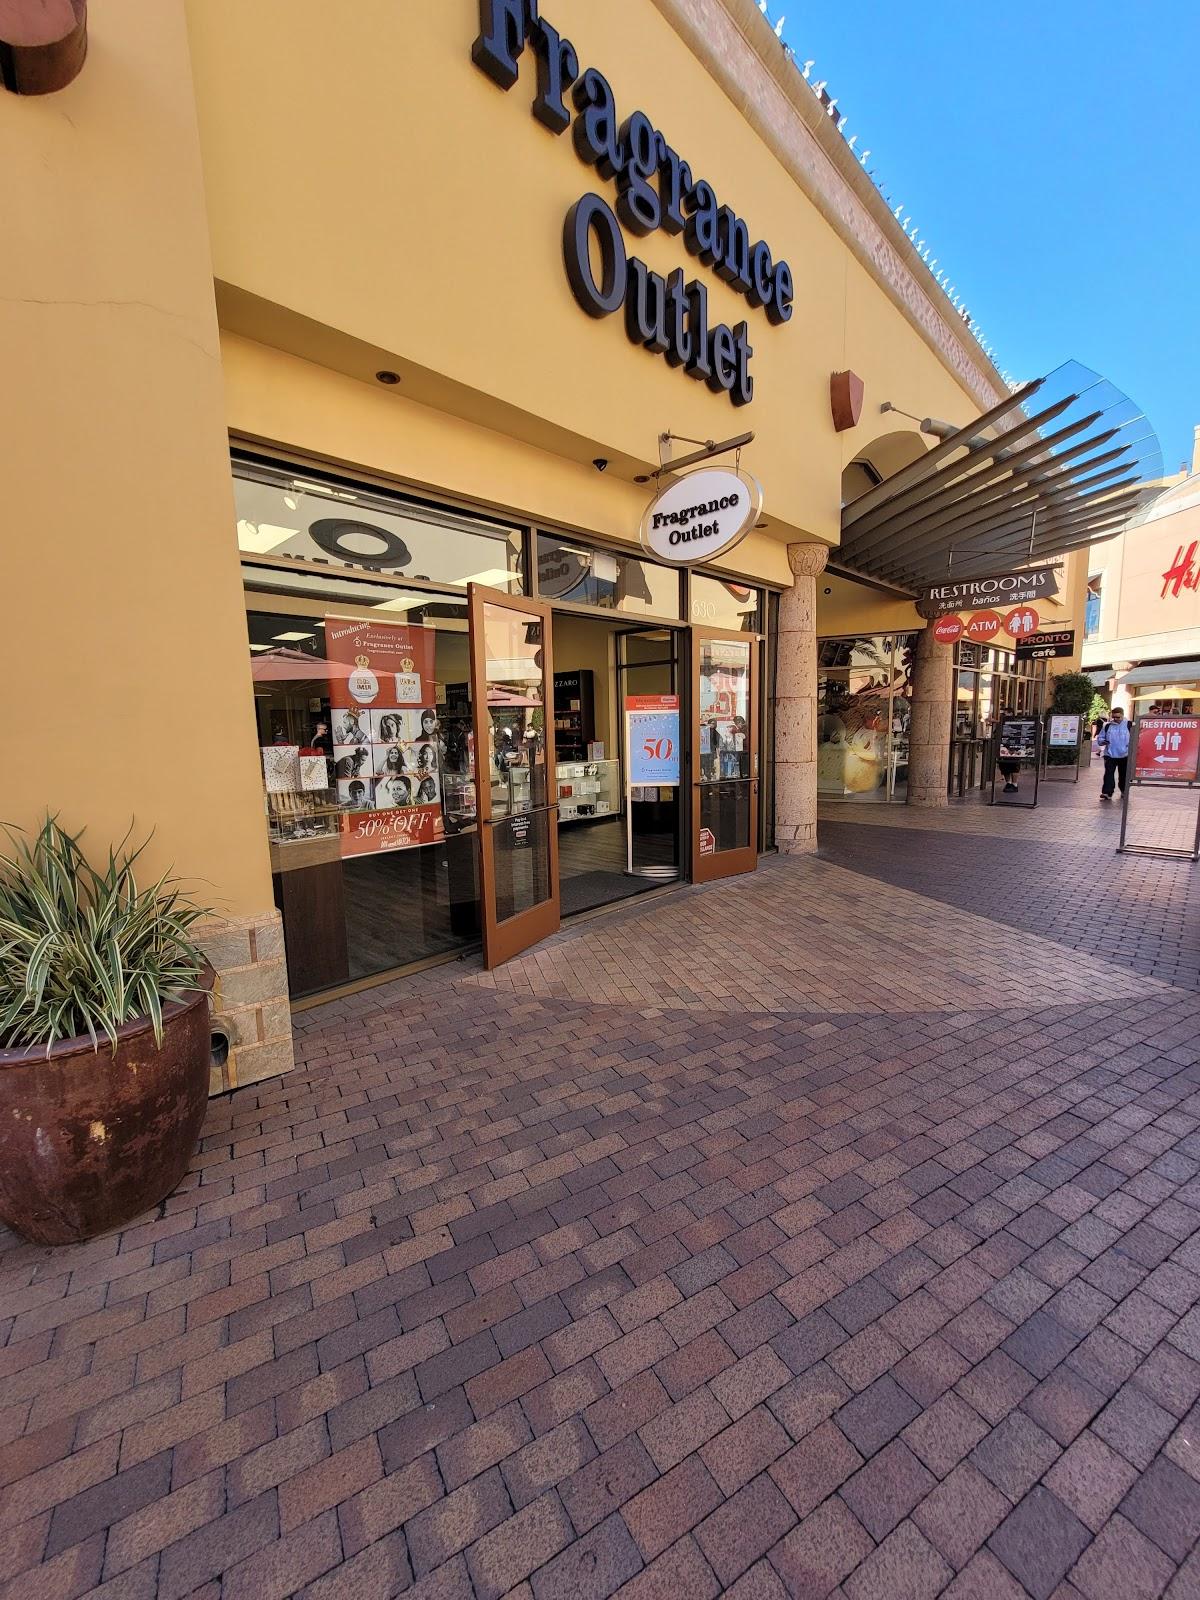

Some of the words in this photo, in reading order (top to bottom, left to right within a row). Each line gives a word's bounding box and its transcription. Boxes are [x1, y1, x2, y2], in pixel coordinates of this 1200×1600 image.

[563, 192, 754, 408] Outlet
[652, 493, 739, 530] Fragrance
[668, 520, 719, 545] Outlet
[1161, 540, 1200, 600] H&
[930, 572, 1047, 600] RESTROOMS
[971, 595, 1000, 606] baños
[331, 622, 371, 640] Introducing
[969, 620, 997, 632] ATM
[1020, 633, 1071, 645] PRONTO
[1031, 647, 1056, 658] café
[554, 679, 578, 688] ZZARO
[1142, 721, 1198, 729] RESTROOMS
[642, 738, 673, 760] 50
[355, 818, 390, 839] 50%
[393, 812, 432, 833] OFF
